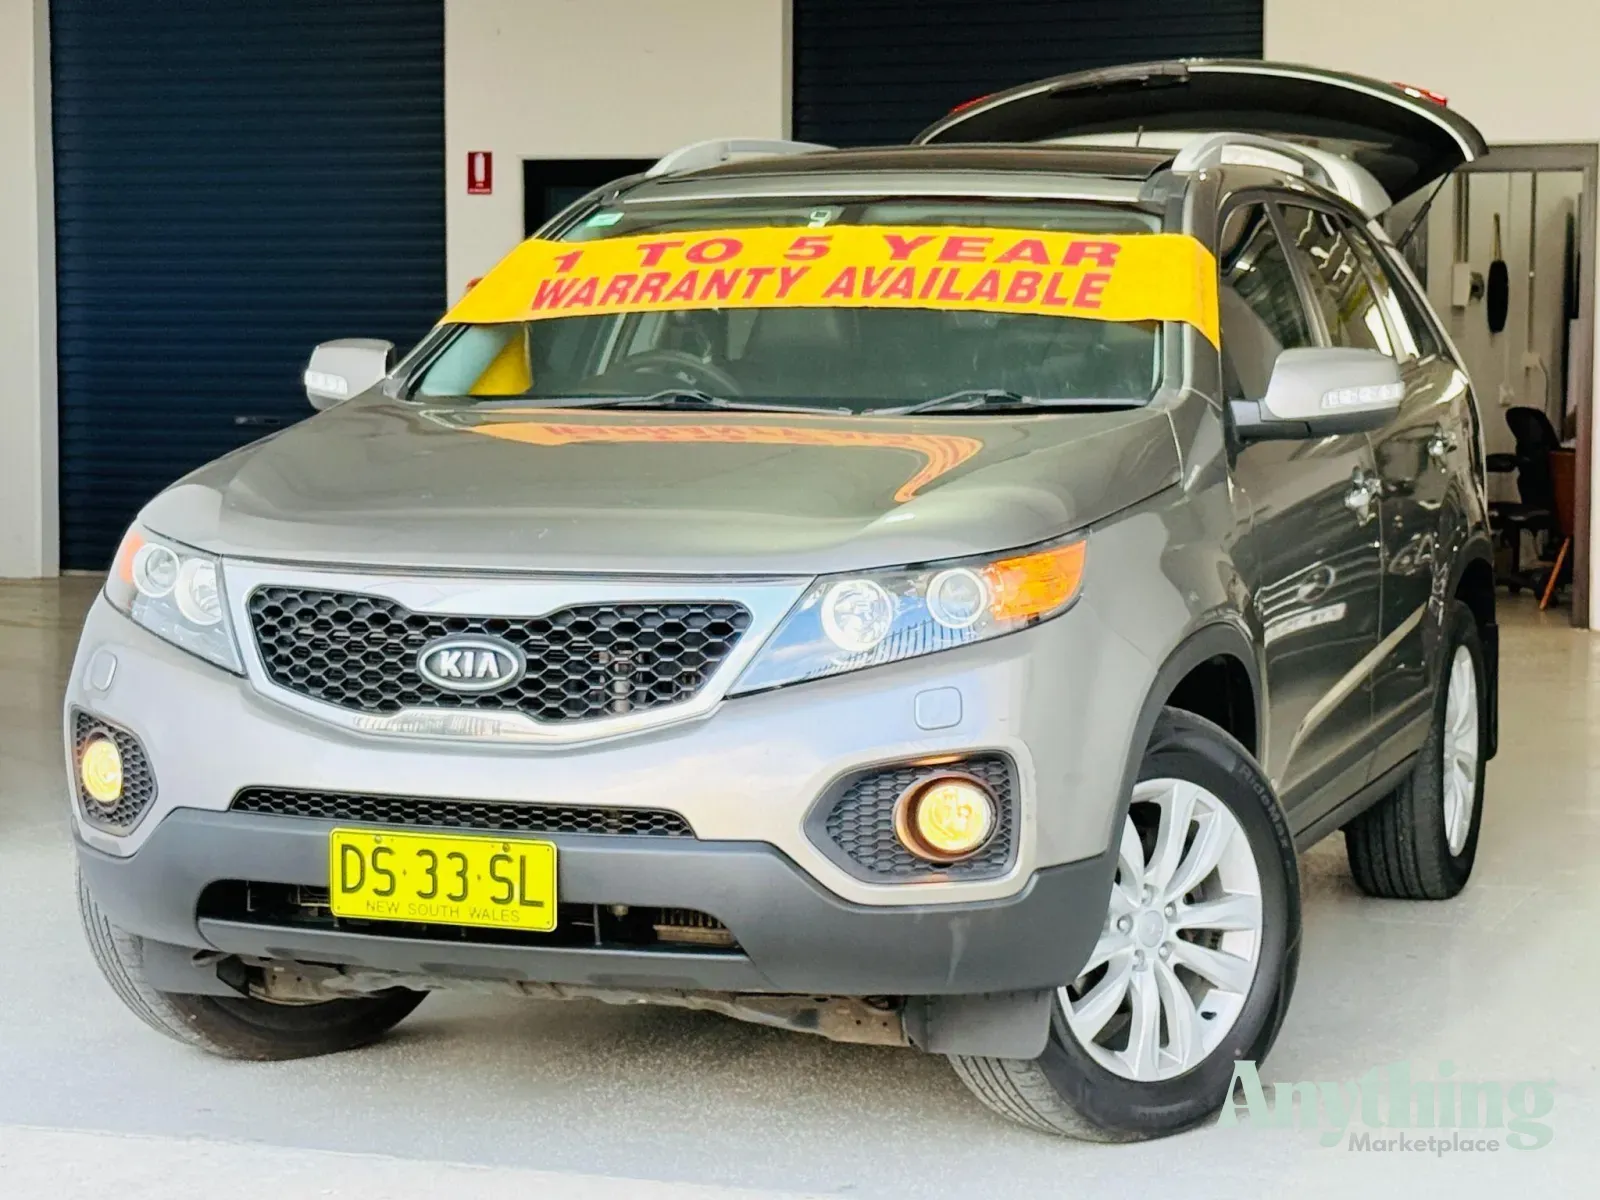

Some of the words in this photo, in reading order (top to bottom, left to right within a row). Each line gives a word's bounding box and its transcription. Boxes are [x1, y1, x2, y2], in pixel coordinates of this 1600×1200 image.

[554, 250, 584, 273] 1
[637, 239, 743, 267] TO
[784, 236, 834, 261] 5
[883, 235, 1121, 267] YEAR
[531, 266, 811, 310] WARRANTY
[822, 266, 1112, 308] AVAILABLE
[440, 650, 500, 678] KIA
[366, 900, 400, 914] NEW
[408, 903, 460, 918] SOUTH
[469, 907, 521, 923] WALES
